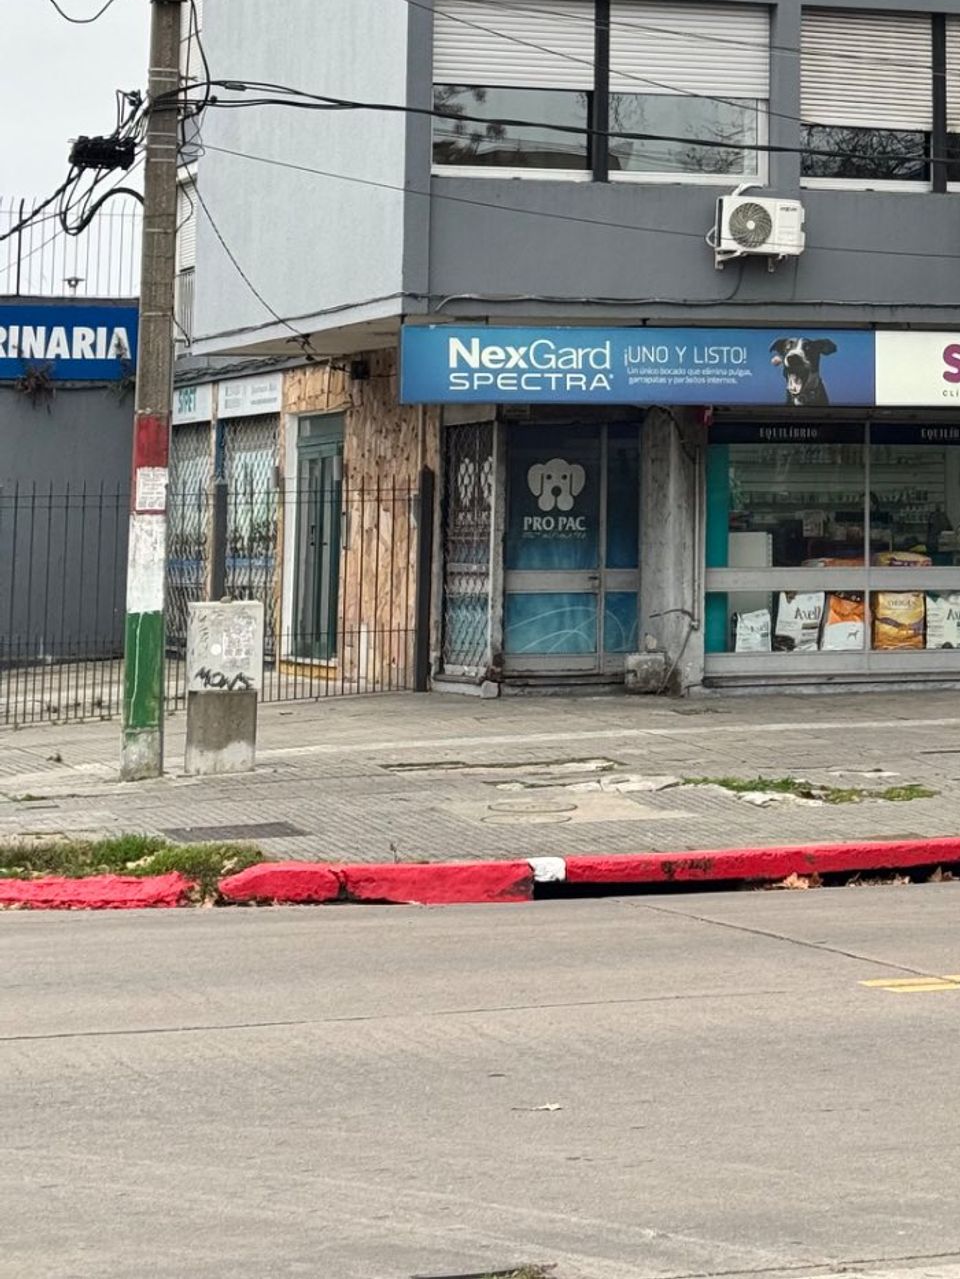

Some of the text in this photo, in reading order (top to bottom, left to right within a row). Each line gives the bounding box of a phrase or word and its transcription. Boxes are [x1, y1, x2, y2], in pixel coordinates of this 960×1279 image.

[449, 337, 611, 370] NexGard
[624, 345, 748, 366] ¡UNO Y LISTO!
[523, 516, 587, 531] PRO PAC
